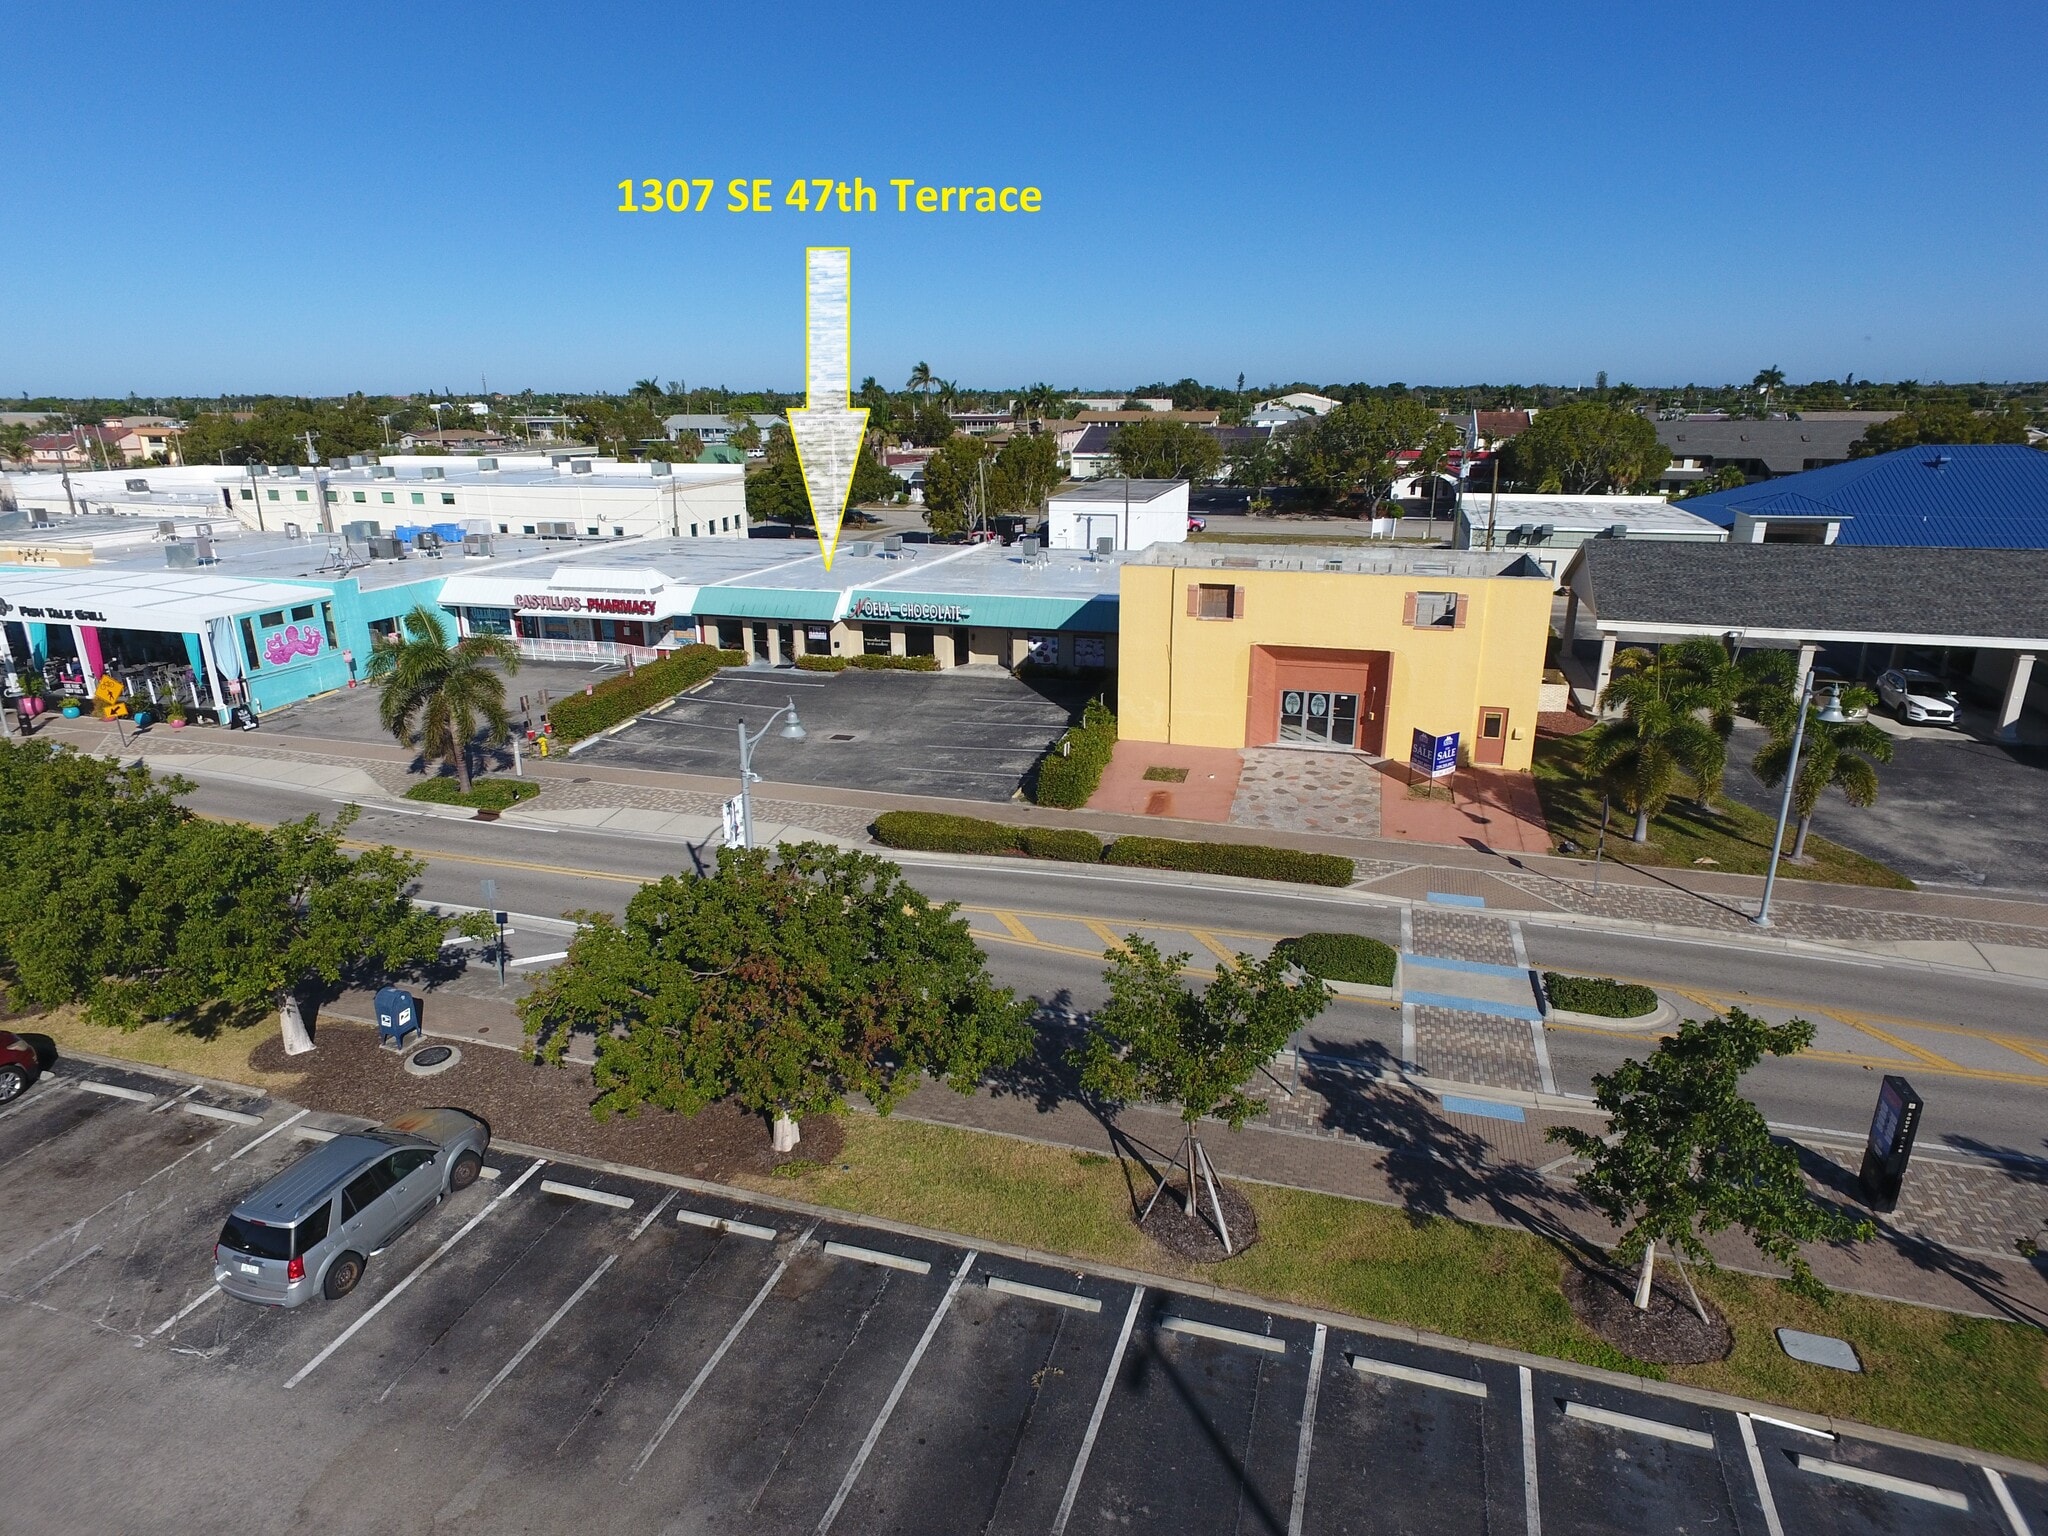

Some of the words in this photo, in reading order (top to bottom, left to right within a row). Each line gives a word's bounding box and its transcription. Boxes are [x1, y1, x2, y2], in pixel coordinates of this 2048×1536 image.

[514, 594, 581, 611] CASTILLO'S
[587, 597, 656, 616] PHARMACY
[848, 597, 892, 618] NOELA
[900, 603, 962, 620] CHOCOLATE
[1413, 744, 1433, 759] SALE
[1436, 747, 1457, 761] SALE
